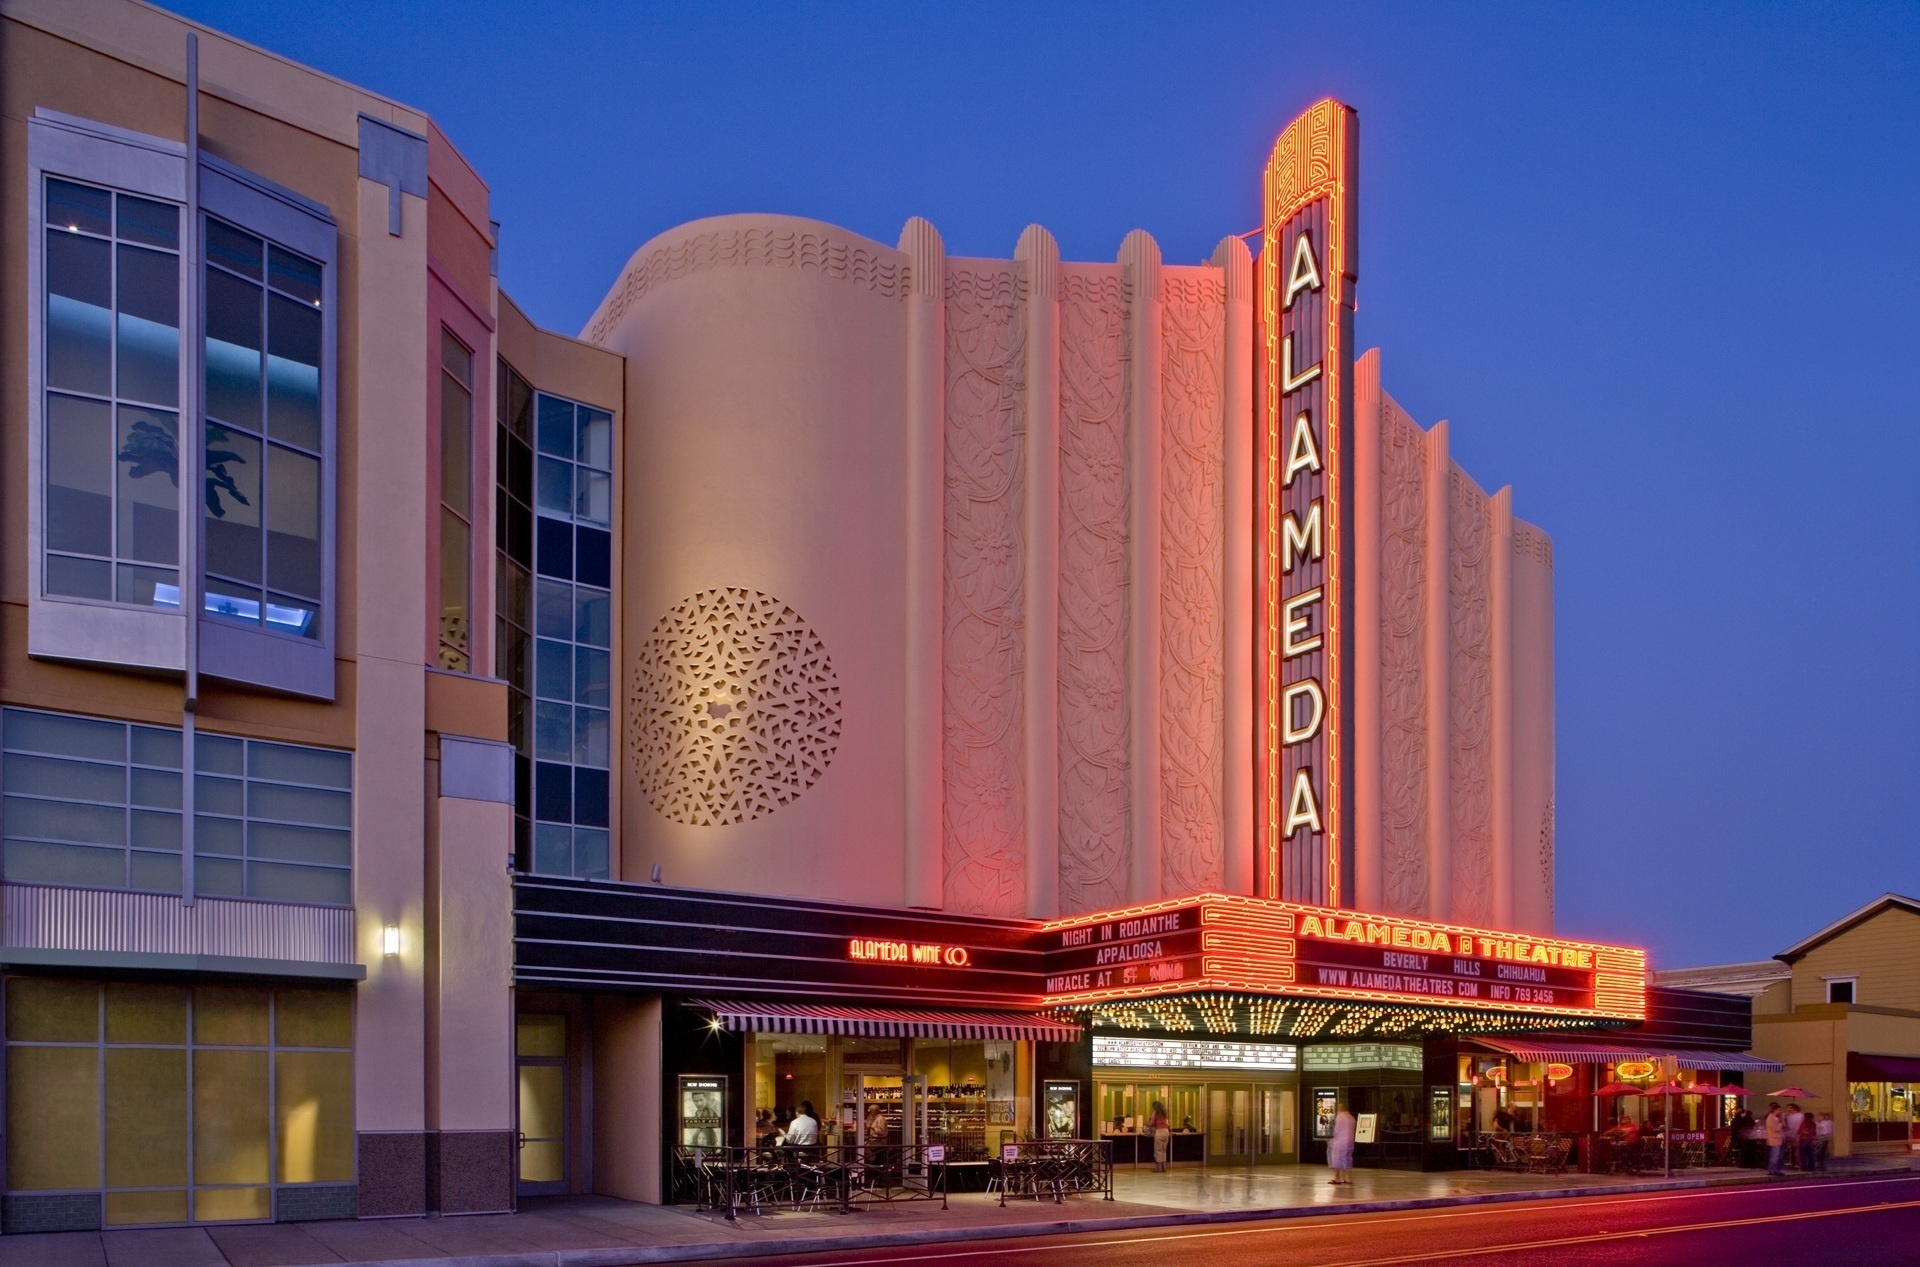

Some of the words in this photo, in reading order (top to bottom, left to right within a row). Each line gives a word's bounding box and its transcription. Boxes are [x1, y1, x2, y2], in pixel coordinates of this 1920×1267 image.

[1282, 229, 1327, 842] ALAMEDA
[1062, 927, 1093, 947] NIGHT
[1101, 925, 1113, 941] IN
[1119, 913, 1180, 938] RODANTHE
[1301, 915, 1452, 953] ALAMEDA
[1479, 938, 1593, 969] THEATRE
[850, 939, 908, 962] ALAMEDA
[912, 944, 942, 964] WINE
[1096, 941, 1163, 965] APPALOOSA
[1383, 951, 1429, 972] BEVERLY
[1453, 959, 1481, 976] HILLS
[1497, 964, 1547, 983] CHIHUAHUA
[1046, 973, 1090, 993] MIRACLE
[1097, 970, 1112, 987] AT
[1318, 968, 1347, 987] WWW
[1458, 982, 1478, 998] COM
[1490, 984, 1511, 1001] INFO
[1515, 987, 1532, 1003] 769
[1533, 988, 1554, 1004] 3456
[1686, 1132, 1705, 1140] OPEN
